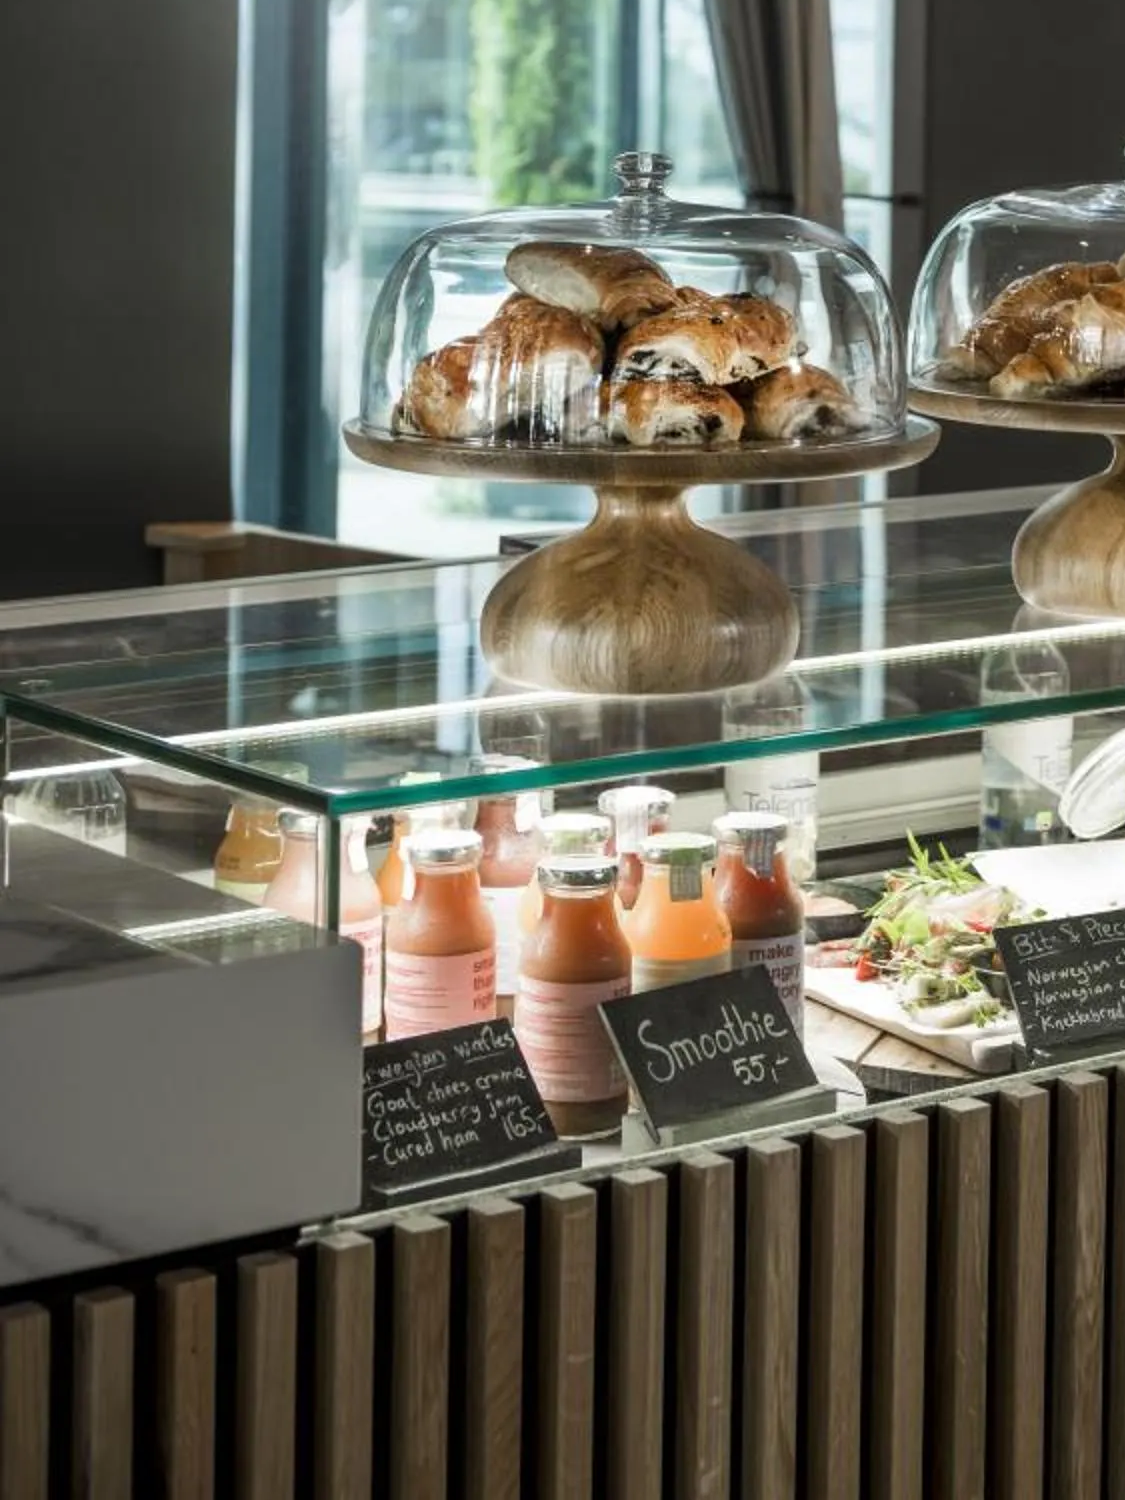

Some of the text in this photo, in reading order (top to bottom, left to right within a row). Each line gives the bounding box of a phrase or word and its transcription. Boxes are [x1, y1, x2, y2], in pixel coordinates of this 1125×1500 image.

[749, 944, 795, 962] make
[637, 1000, 789, 1083] Smoothie
[367, 1090, 421, 1118] Goat
[372, 1092, 523, 1141] Cloudberry jam
[383, 1137, 435, 1166] Cured
[440, 1130, 480, 1151] ham
